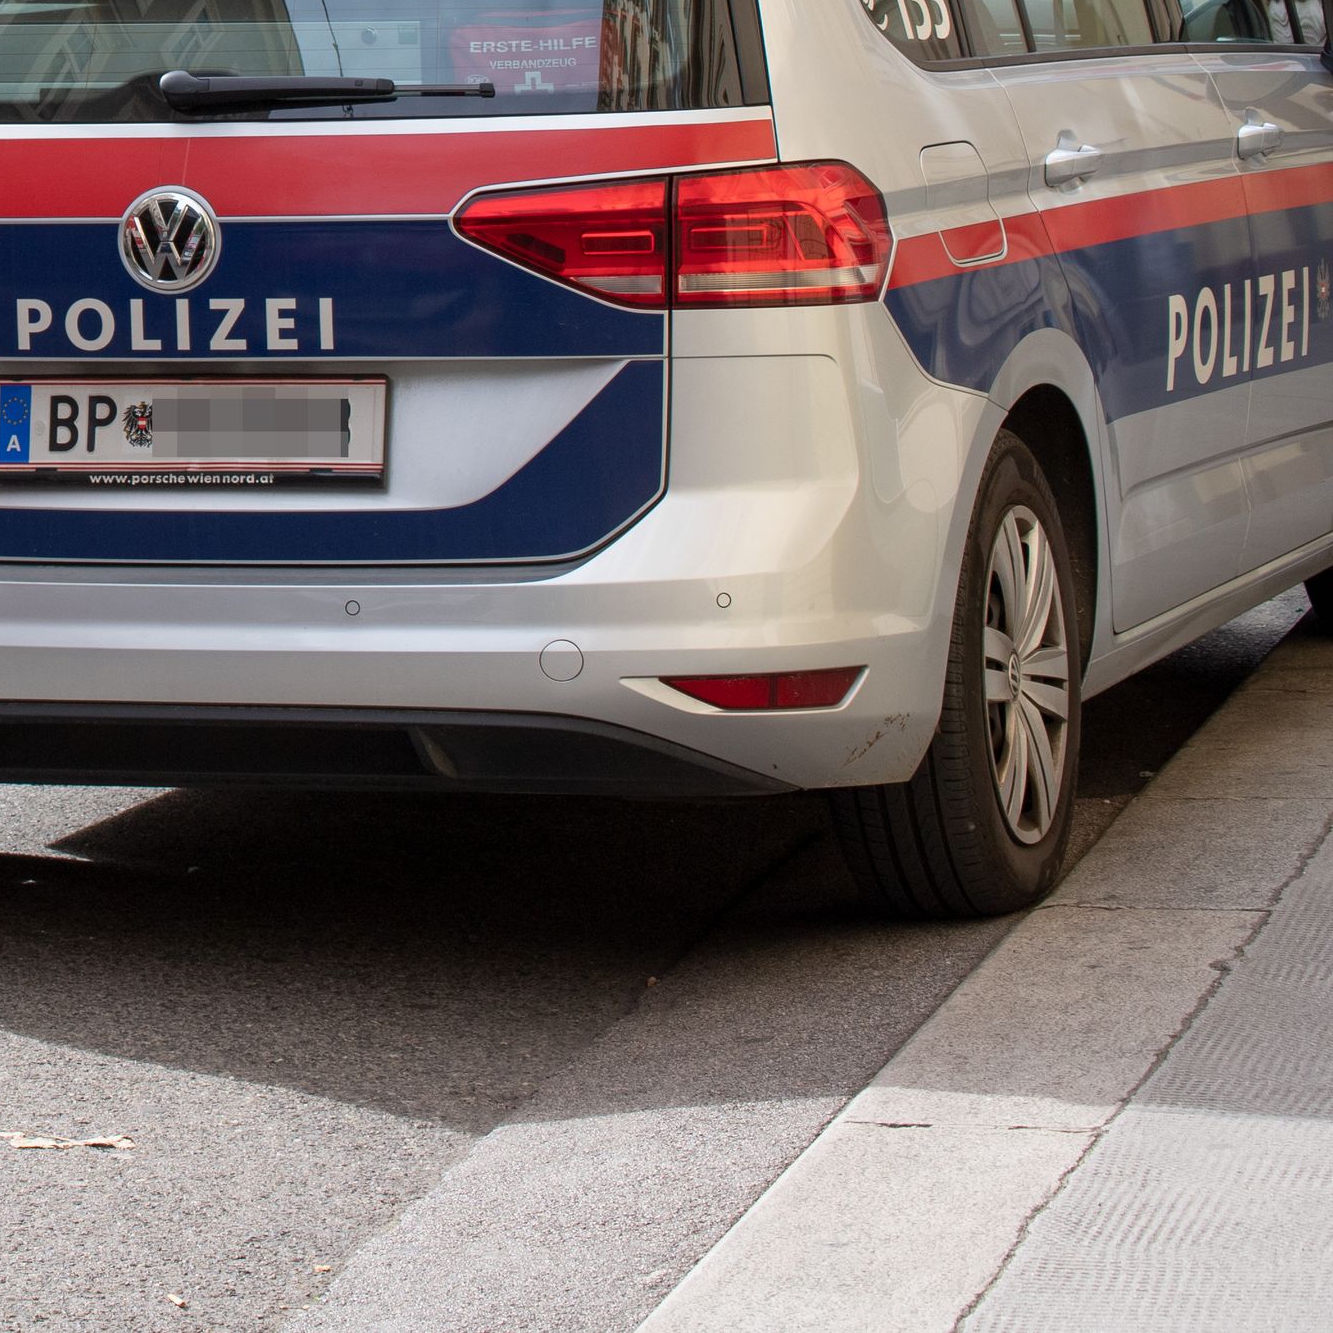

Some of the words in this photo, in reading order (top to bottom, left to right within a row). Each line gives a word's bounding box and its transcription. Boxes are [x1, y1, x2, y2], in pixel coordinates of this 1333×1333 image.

[468, 36, 598, 53] ERSTE-HILFE
[489, 57, 577, 70] VERBANDZEUG
[16, 297, 334, 351] POLIZEI
[1166, 266, 1310, 392] POLIZEI
[48, 394, 118, 453] BP
[6, 435, 22, 453] A
